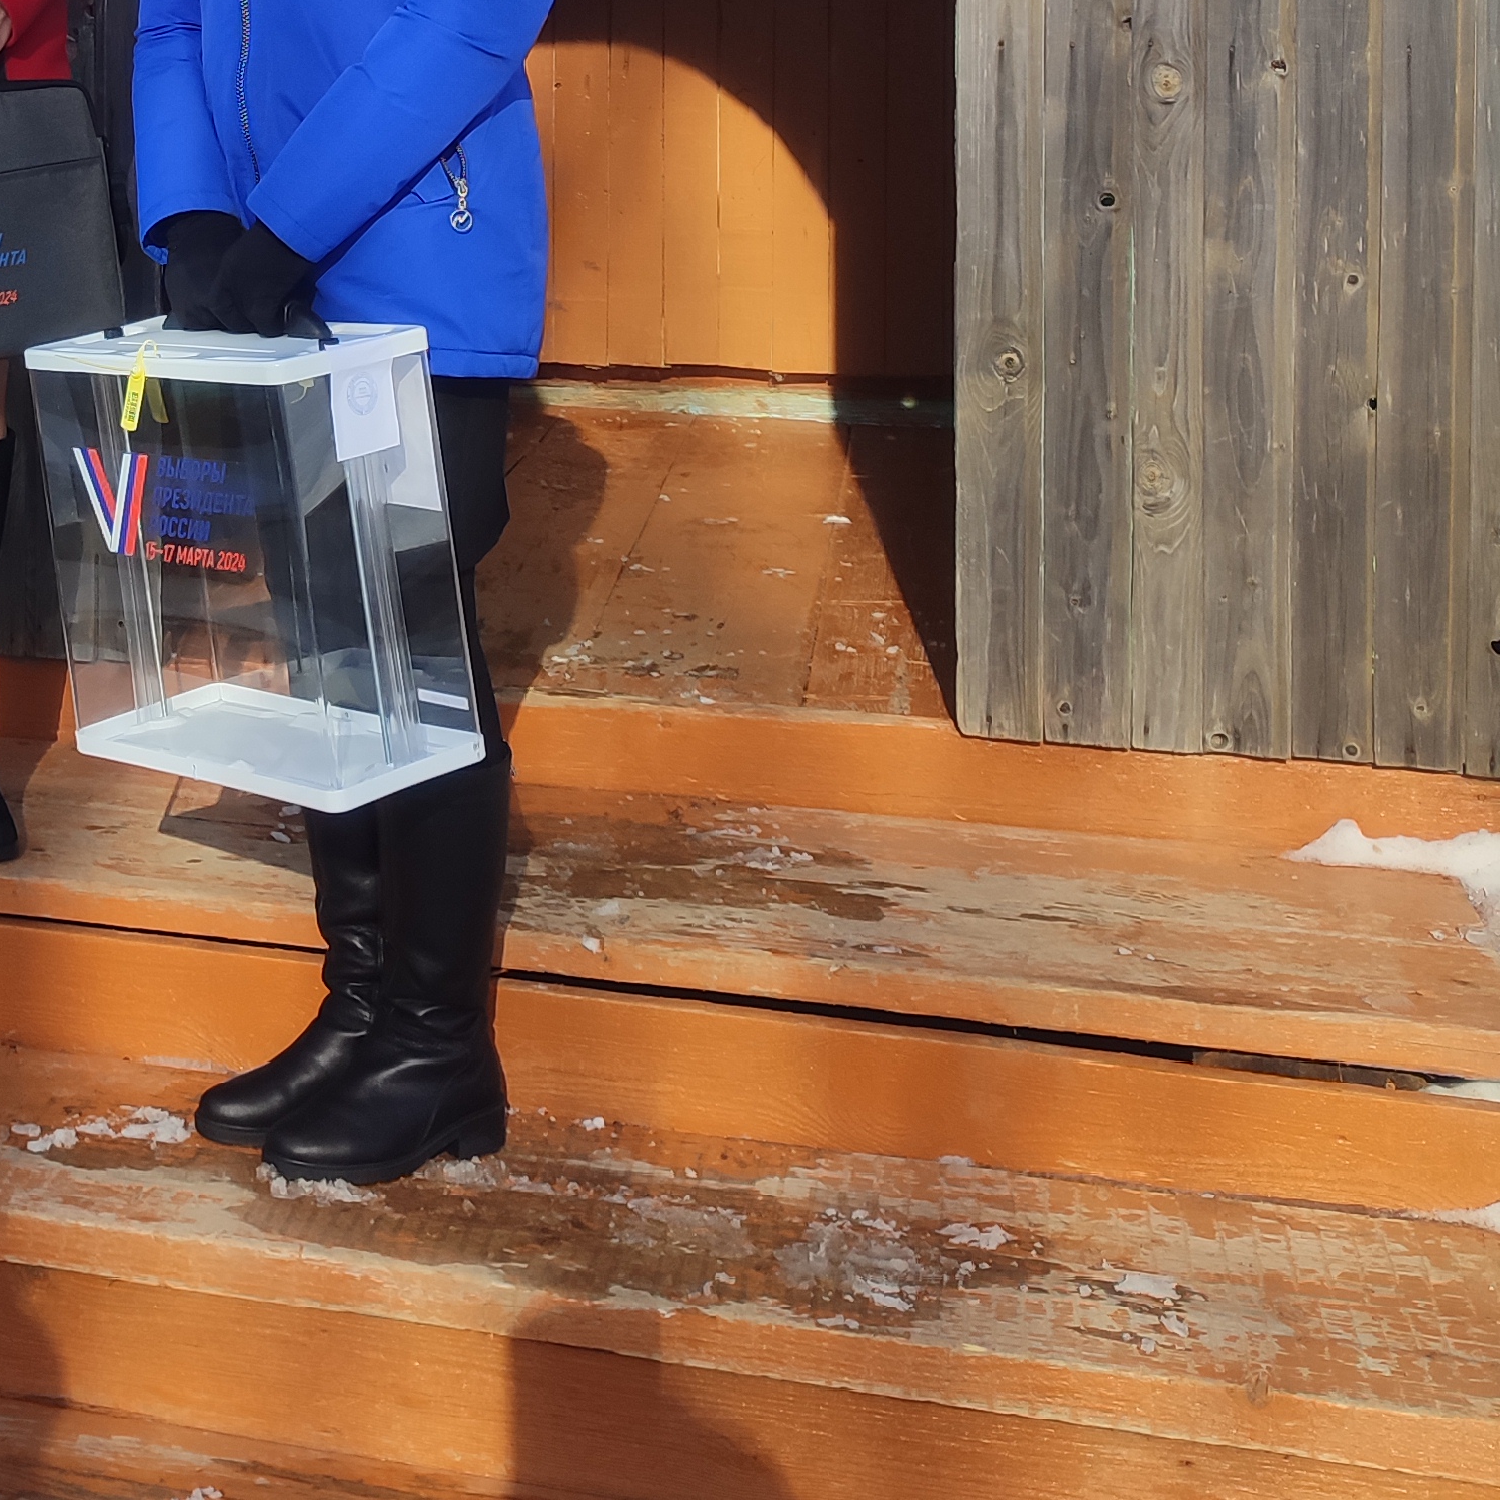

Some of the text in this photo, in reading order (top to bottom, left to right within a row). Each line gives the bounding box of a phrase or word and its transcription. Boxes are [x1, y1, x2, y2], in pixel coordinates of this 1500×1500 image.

[157, 456, 227, 484] ВЫБОРЫ
[154, 487, 256, 516] ПРЕЗИДЕНТА
[176, 546, 214, 570] МАРТА
[214, 551, 246, 572] 2024
